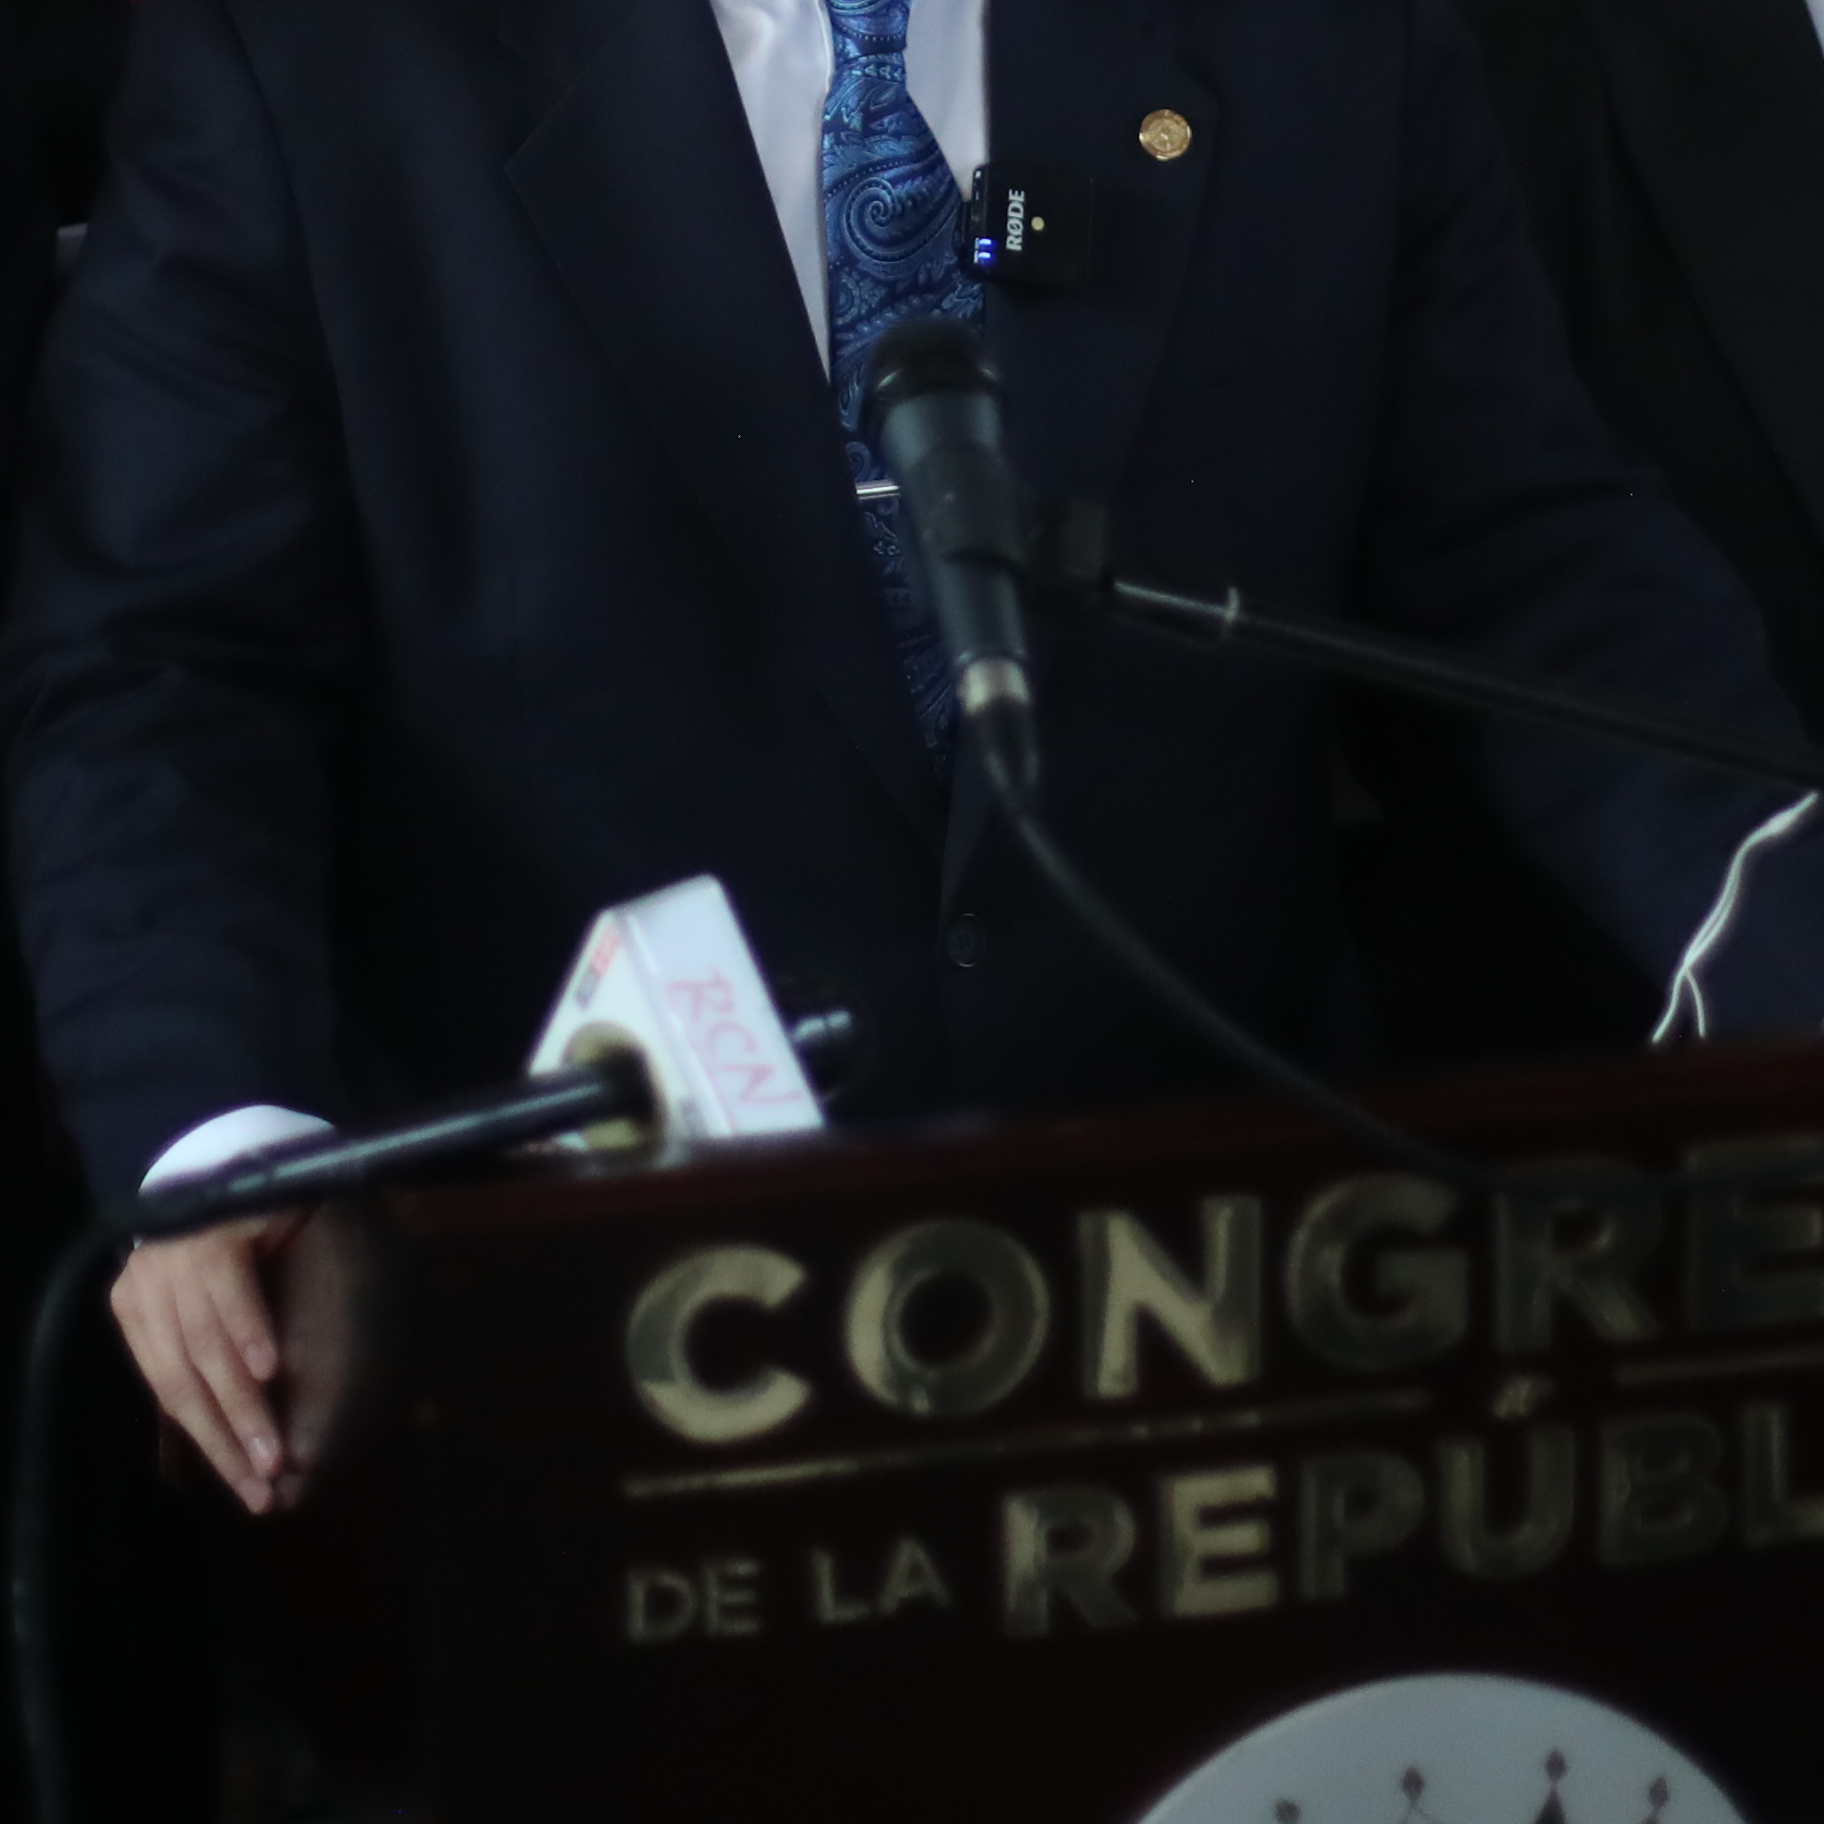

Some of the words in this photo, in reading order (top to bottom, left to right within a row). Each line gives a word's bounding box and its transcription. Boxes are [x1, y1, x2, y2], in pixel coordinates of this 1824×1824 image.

[1006, 189, 1025, 251] RØDE
[664, 964, 806, 1104] RCN
[626, 1556, 762, 1643] DE
[810, 1533, 952, 1626] LA
